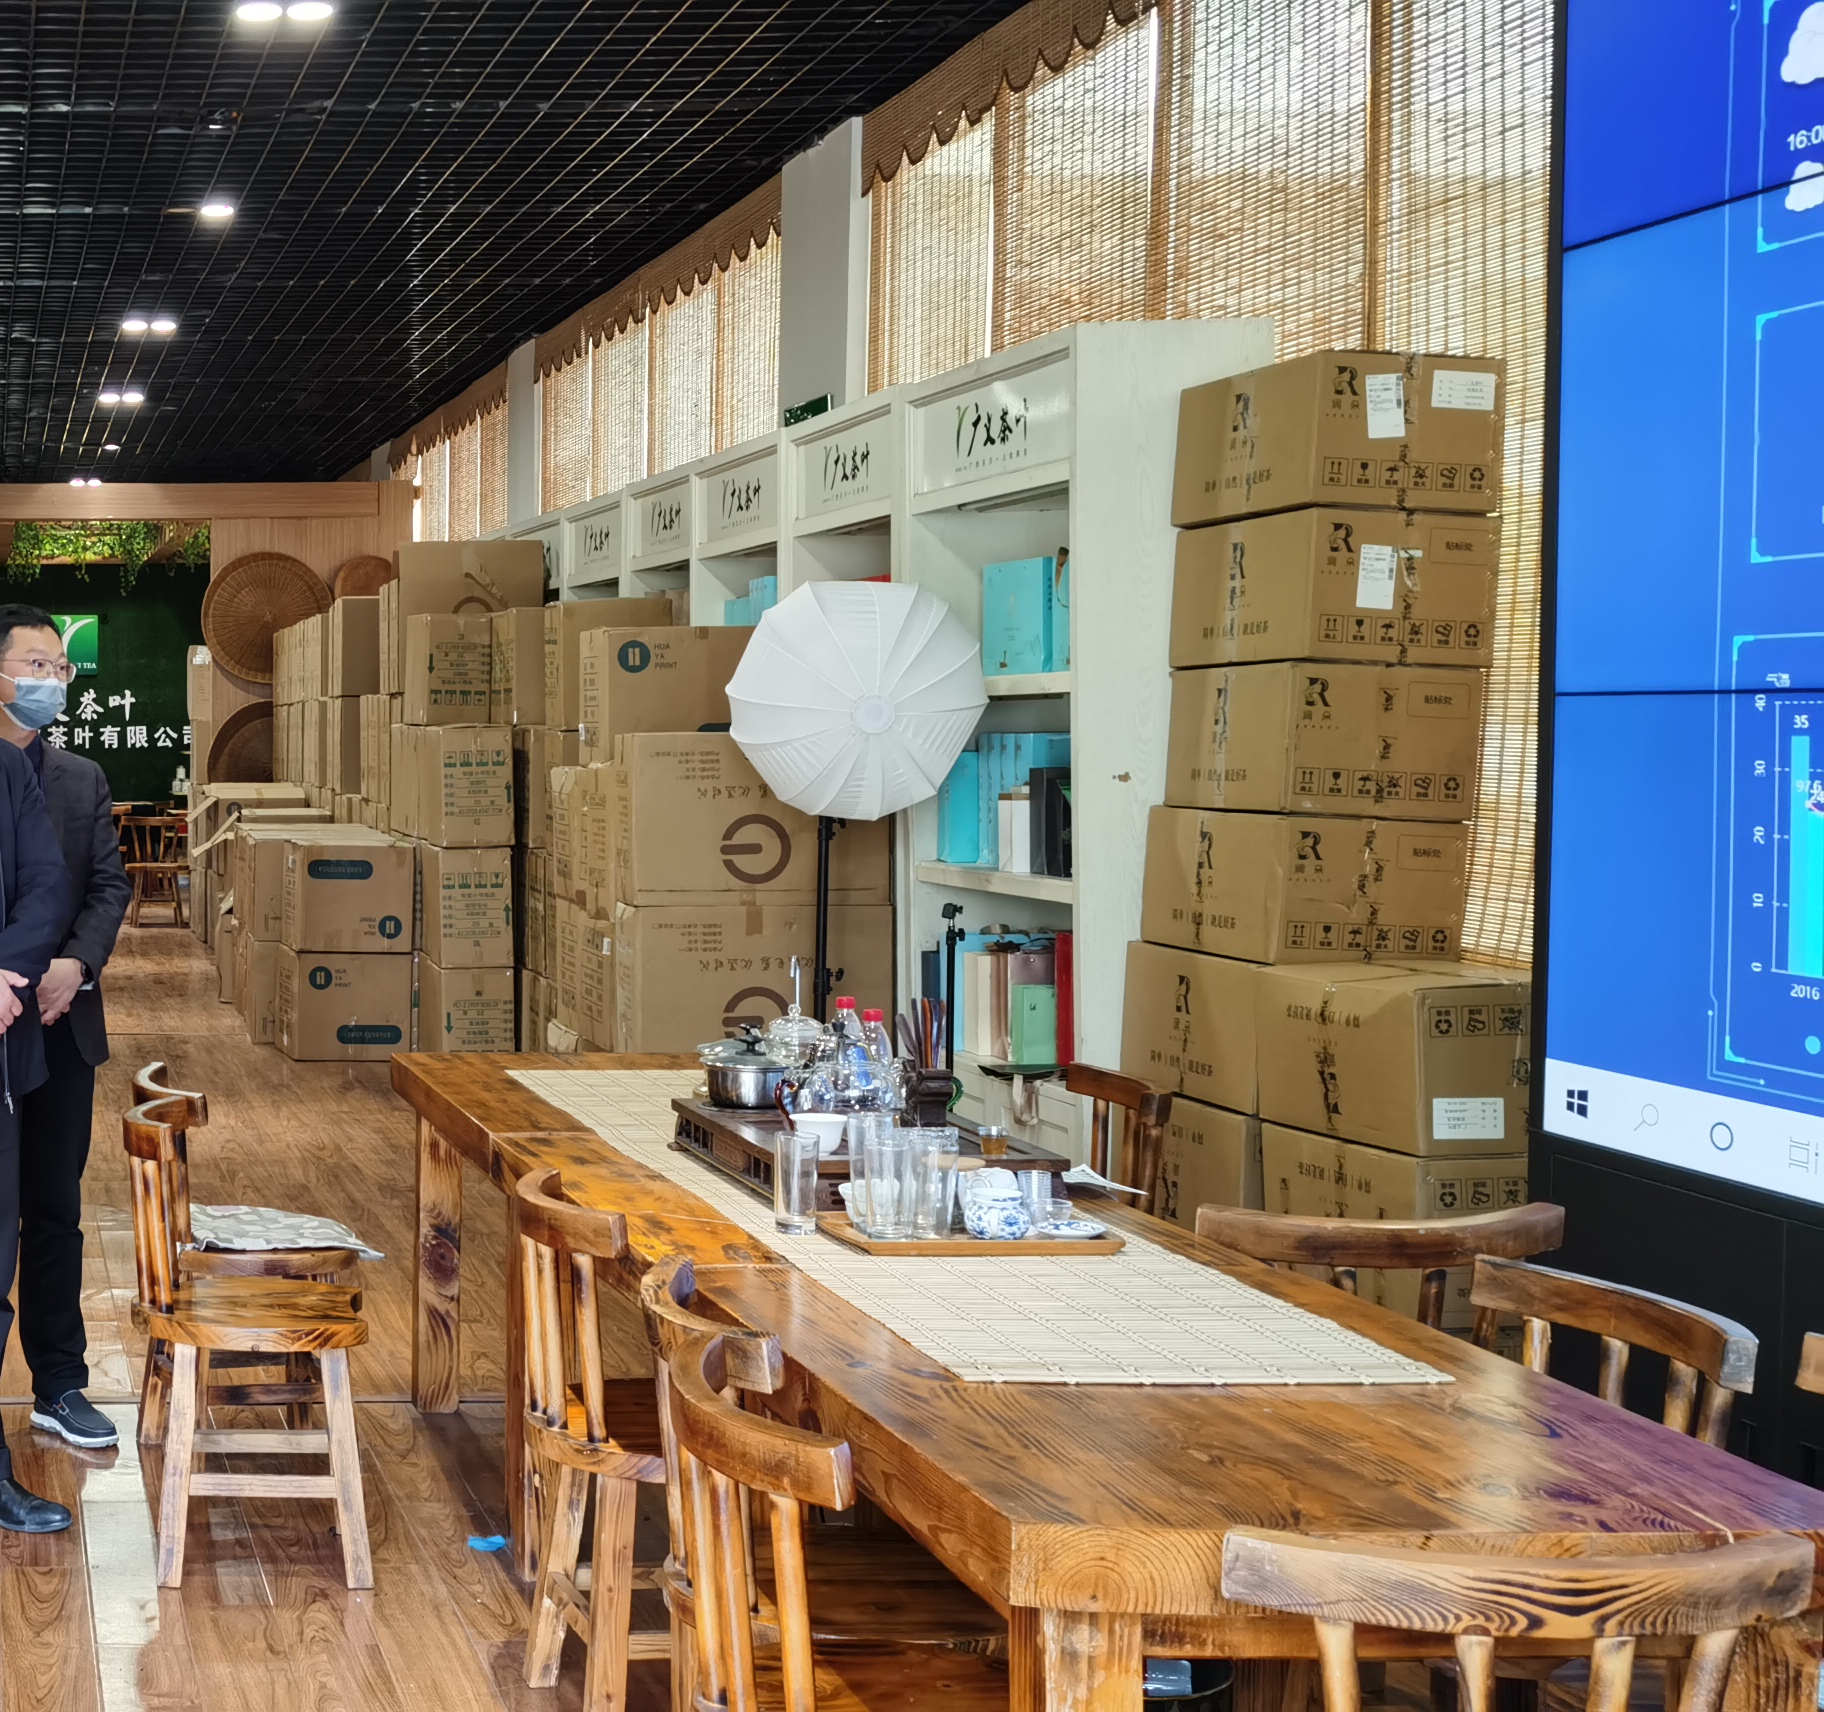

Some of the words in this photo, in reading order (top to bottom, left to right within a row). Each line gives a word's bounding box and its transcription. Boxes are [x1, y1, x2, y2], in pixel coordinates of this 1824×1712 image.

[1755, 694, 1767, 711] 40
[1793, 715, 1809, 728] 35
[1754, 760, 1766, 777] 30
[1753, 826, 1766, 844] 20
[1752, 893, 1764, 908] 10
[1751, 962, 1763, 972] 0
[1790, 984, 1820, 1000] 2016
